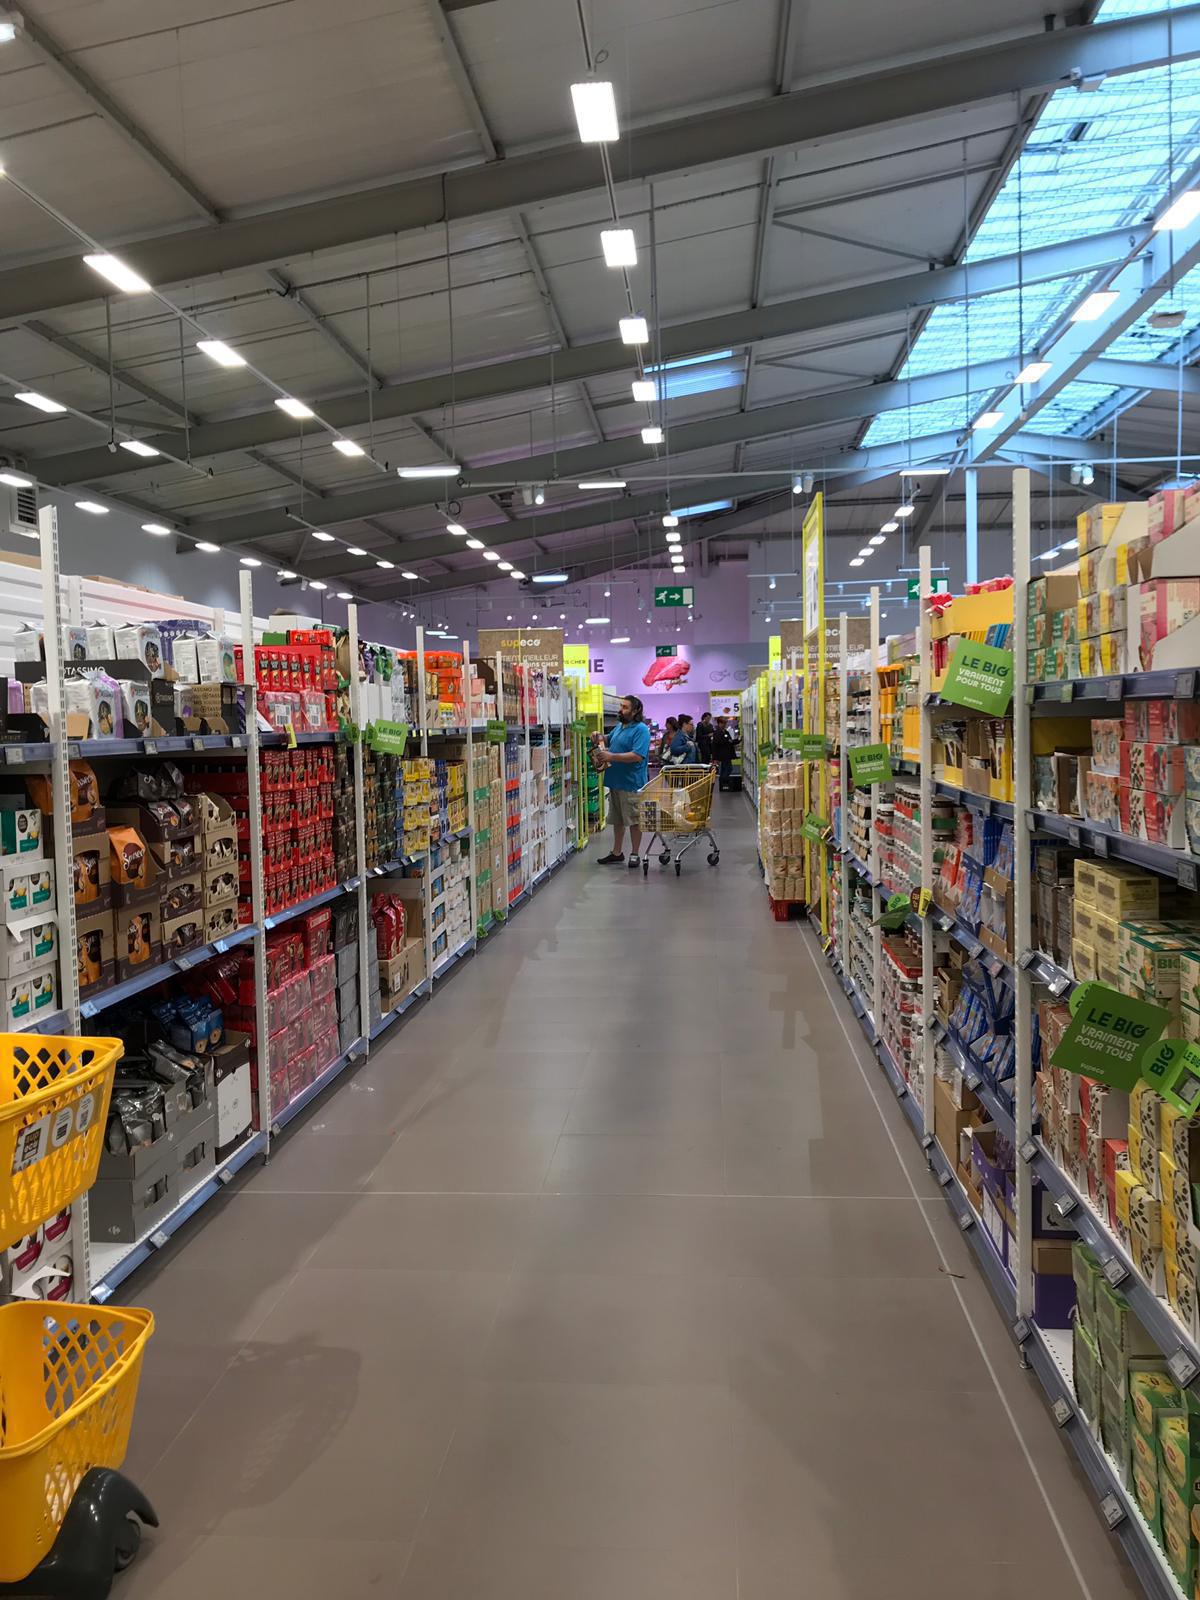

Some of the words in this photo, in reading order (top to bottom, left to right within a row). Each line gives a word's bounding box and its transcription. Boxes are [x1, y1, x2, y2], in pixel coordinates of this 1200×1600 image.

[501, 639, 541, 649] supeco
[66, 666, 106, 676] TASSIMO
[961, 655, 980, 669] LE
[983, 661, 1010, 677] BIO
[956, 675, 979, 688] POUR
[980, 682, 1003, 695] TOUS
[959, 667, 1005, 687] VRAIMENT
[855, 755, 866, 763] LE
[1086, 1007, 1113, 1028] LE
[1112, 1017, 1149, 1039] BIO
[1074, 1035, 1104, 1051] POUR
[1106, 1045, 1134, 1062] TOUS
[1081, 1025, 1140, 1051] VRAIMENT
[1149, 1043, 1175, 1077] BIO
